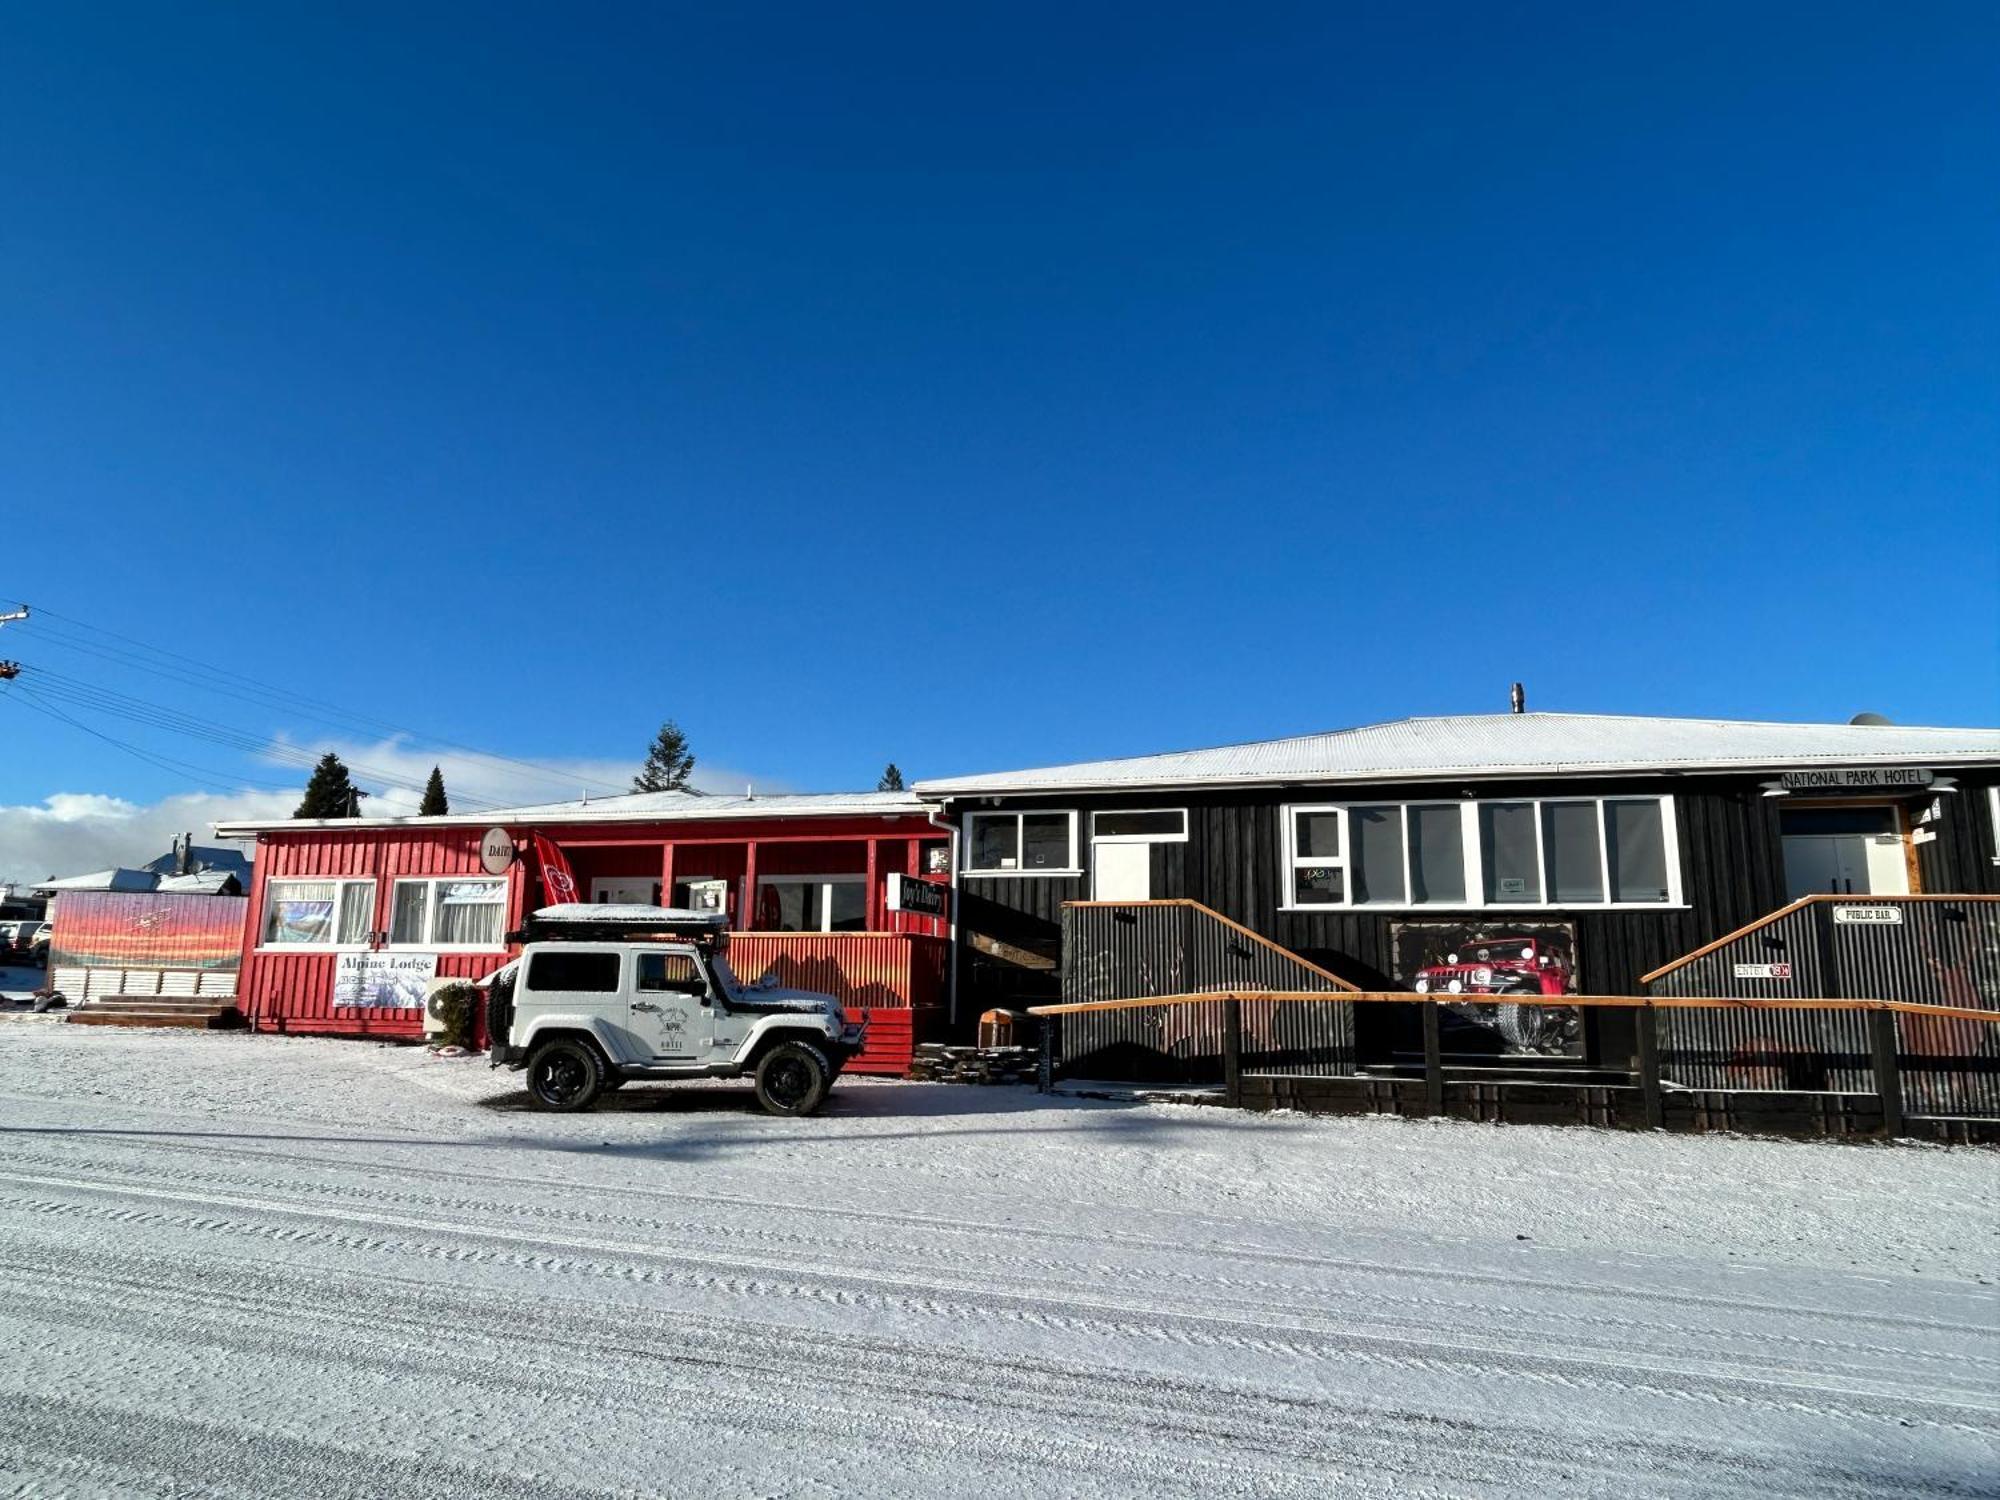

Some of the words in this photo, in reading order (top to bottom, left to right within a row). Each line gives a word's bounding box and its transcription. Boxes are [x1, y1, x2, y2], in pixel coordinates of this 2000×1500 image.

[1783, 771, 1843, 787] NATIONAL
[1846, 770, 1877, 784] PARK
[1885, 769, 1925, 783] HOTEL
[1846, 910, 1873, 920] PUBLIC
[341, 956, 386, 971] Alpine
[390, 958, 432, 972] Lodge
